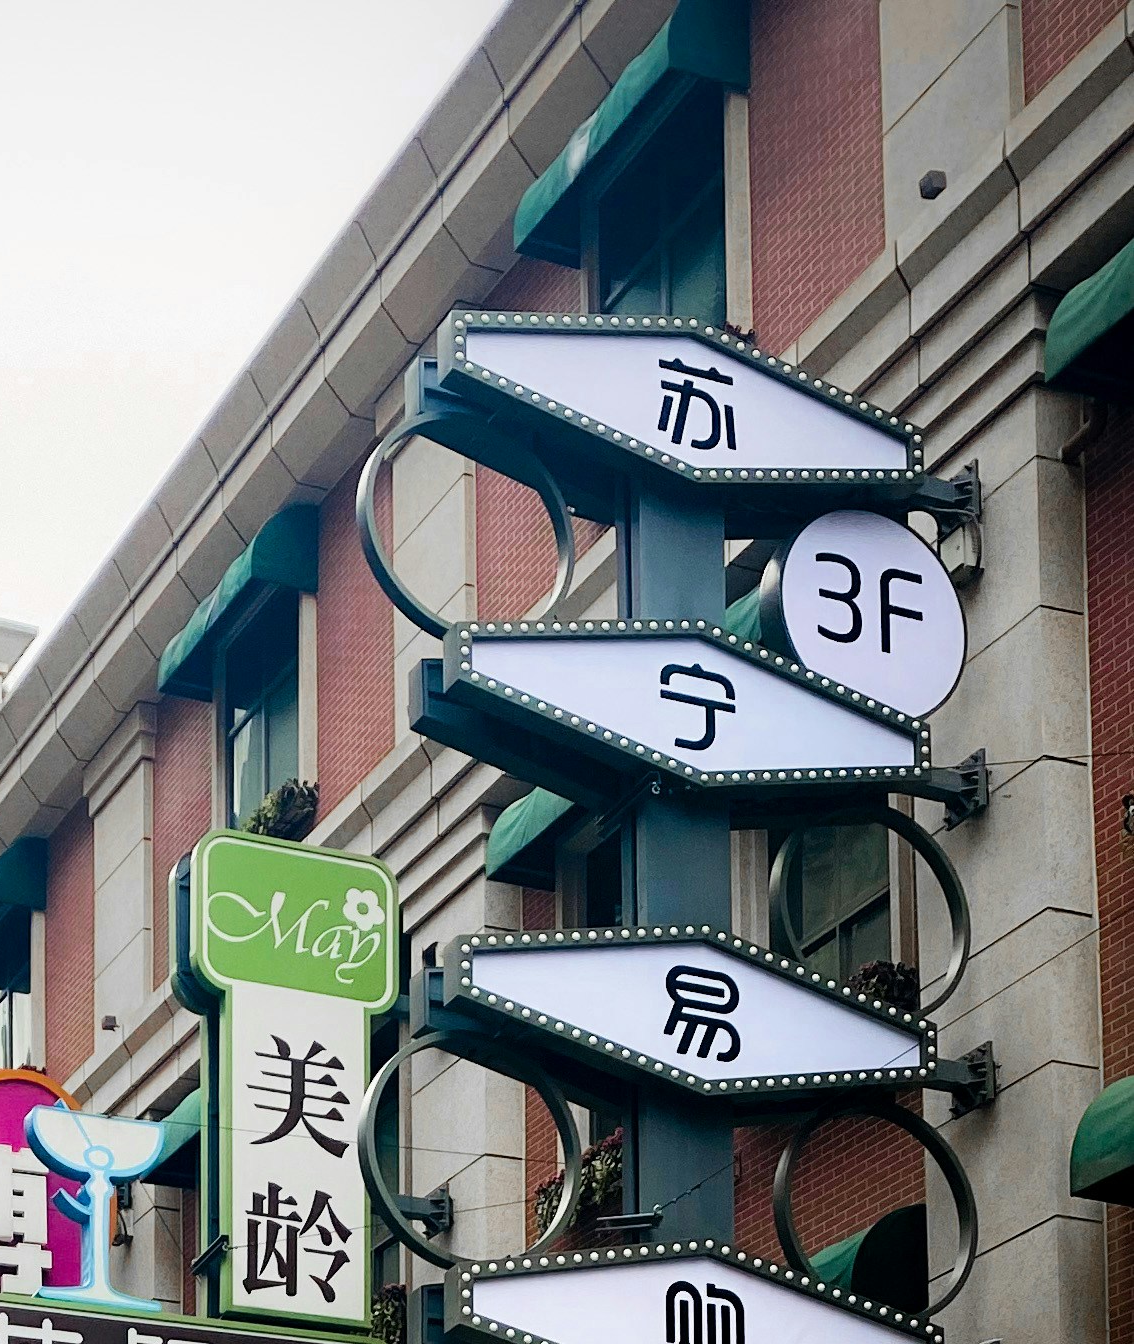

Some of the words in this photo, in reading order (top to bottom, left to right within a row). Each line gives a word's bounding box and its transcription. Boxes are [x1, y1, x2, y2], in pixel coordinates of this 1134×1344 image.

[814, 552, 924, 654] 3F
[207, 888, 382, 985] May
[243, 1033, 353, 1304] 美龄
